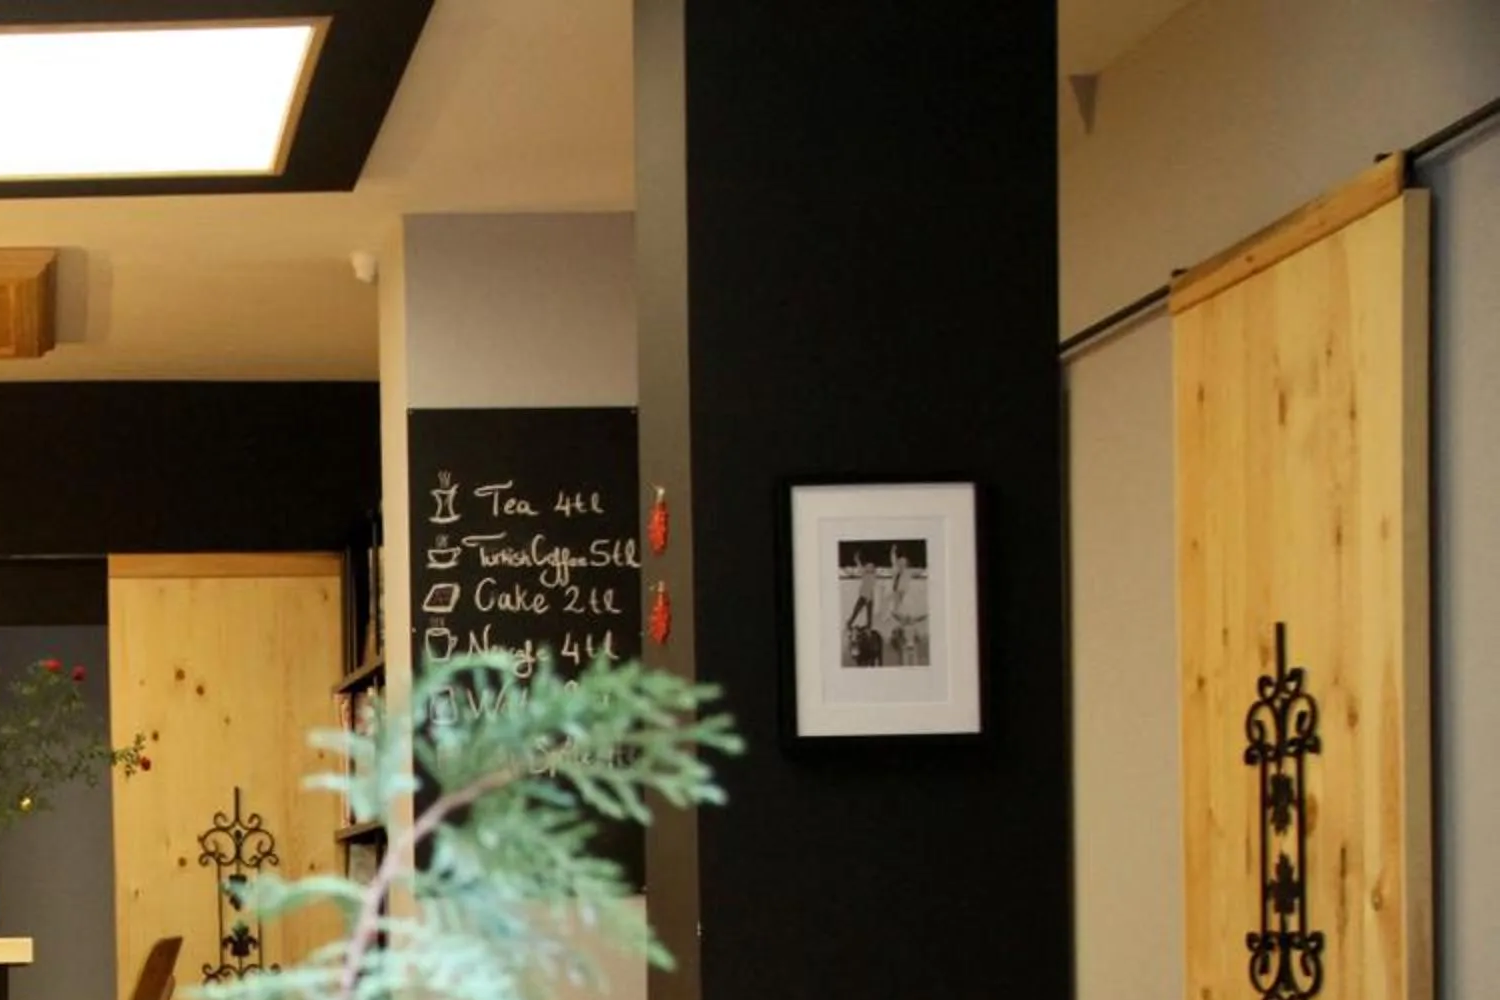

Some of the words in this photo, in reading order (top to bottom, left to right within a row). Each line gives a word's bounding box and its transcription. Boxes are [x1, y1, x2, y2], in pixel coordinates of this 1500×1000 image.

[473, 479, 540, 517] Tea
[461, 532, 532, 567] Turkish
[531, 533, 587, 588] Coffee
[474, 577, 550, 614] Cake
